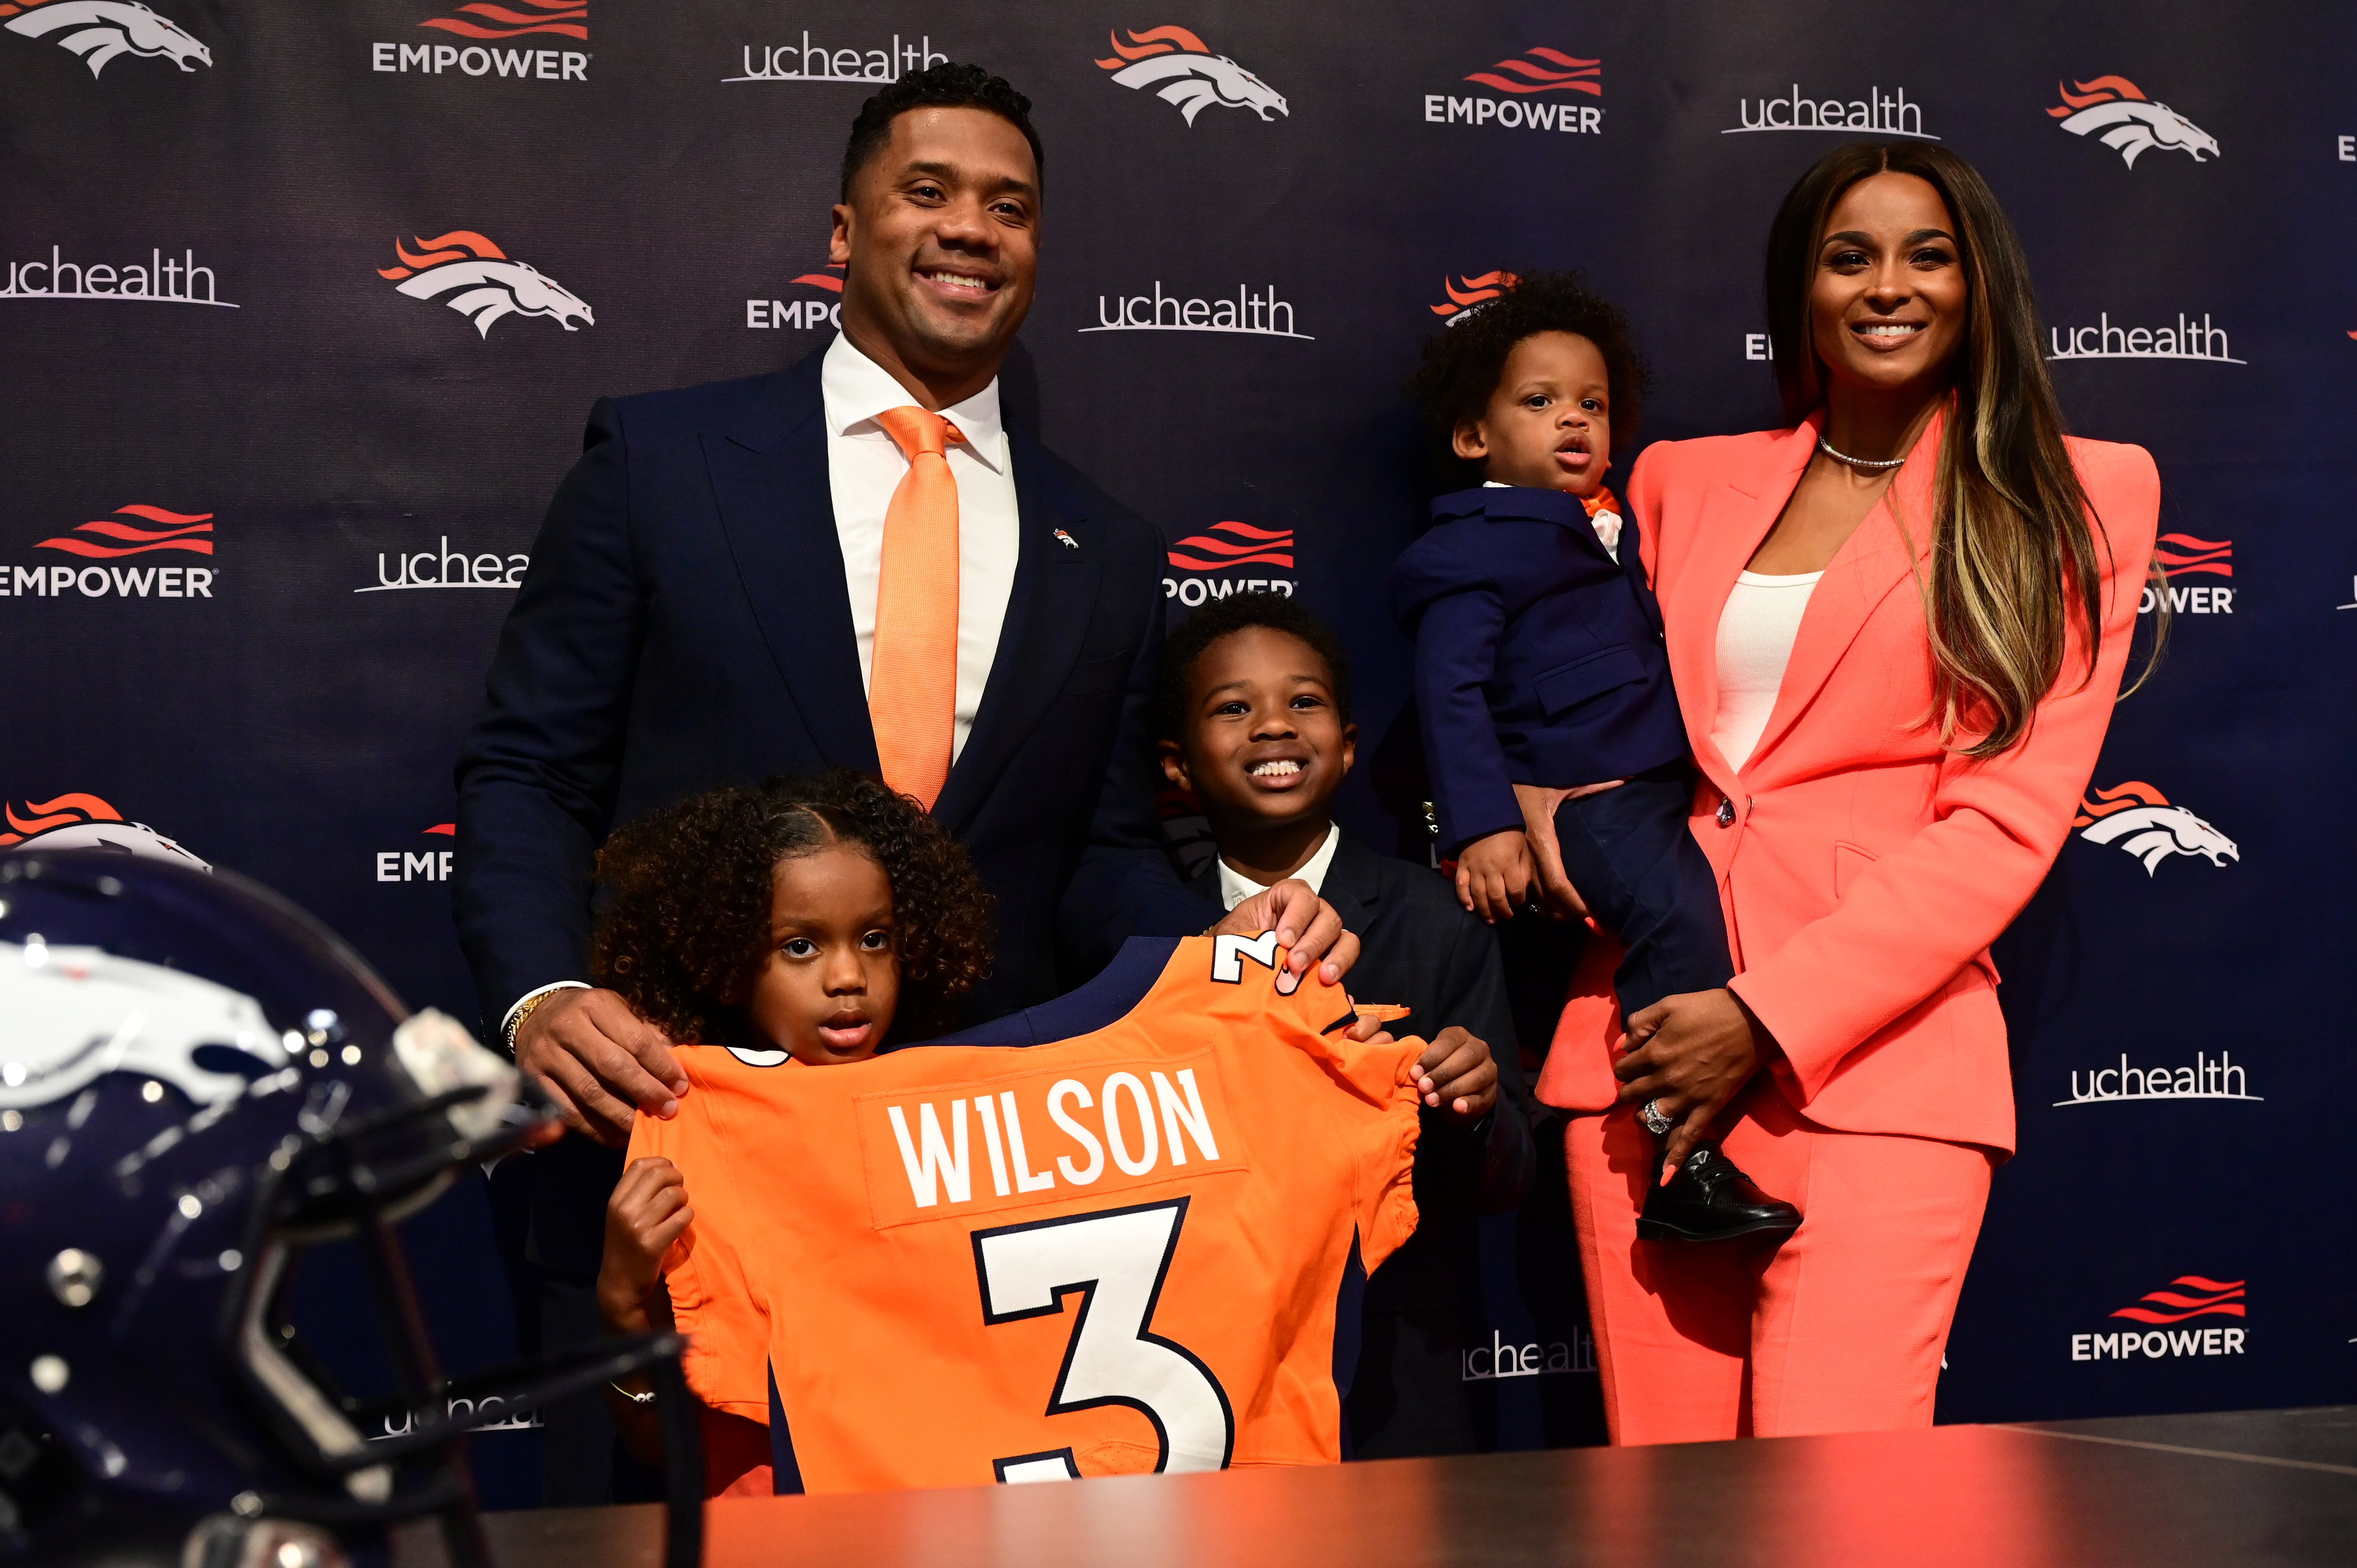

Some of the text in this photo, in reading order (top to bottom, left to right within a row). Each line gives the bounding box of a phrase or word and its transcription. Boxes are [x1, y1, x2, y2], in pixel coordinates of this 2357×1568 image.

[373, 43, 587, 81] EMPOWER
[744, 30, 949, 79] uchealth
[1425, 94, 1601, 134] EMPOWER
[1741, 83, 1922, 135] uchealth
[1100, 281, 1293, 334] uchealth
[2052, 312, 2228, 358] uchealth
[2072, 1050, 2245, 1099] uchealth
[887, 1068, 1220, 1207] WILSON
[970, 1195, 1235, 1485] 3
[1463, 1325, 1597, 1381] chealt
[2072, 1328, 2245, 1361] EMPOWER
